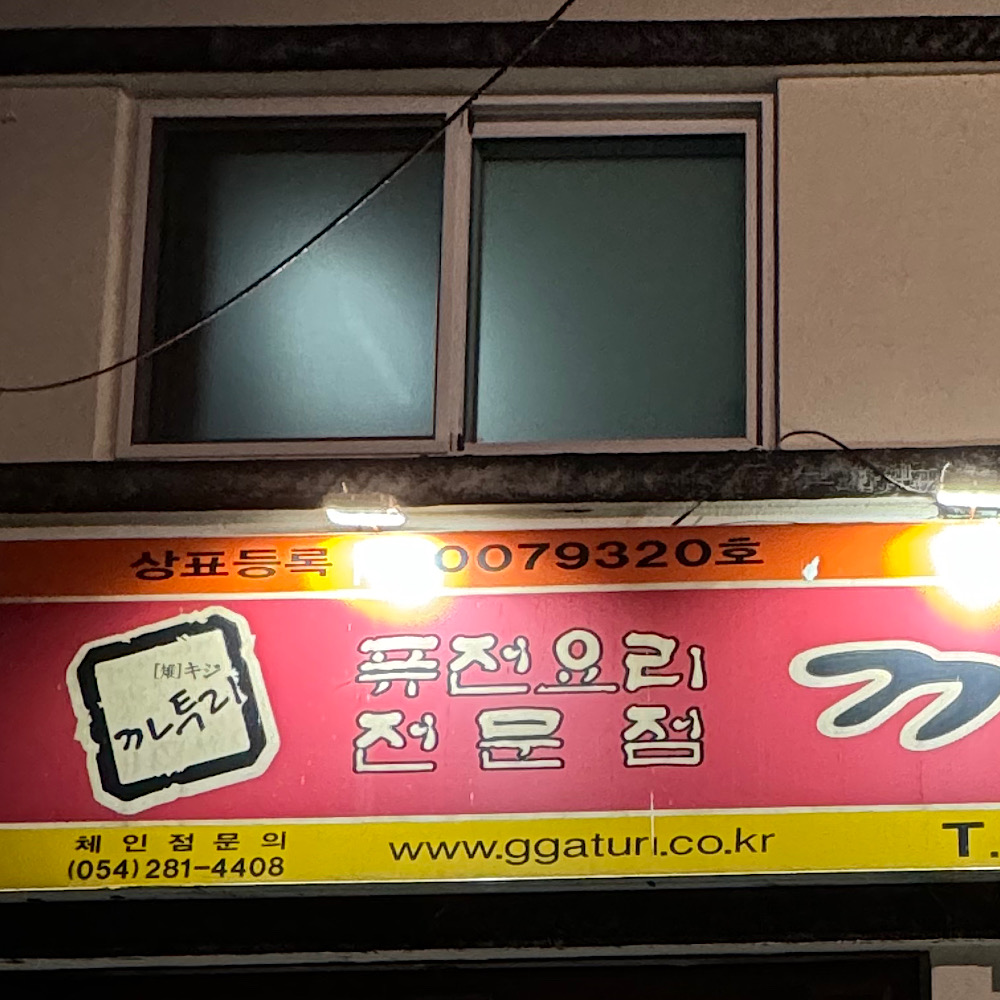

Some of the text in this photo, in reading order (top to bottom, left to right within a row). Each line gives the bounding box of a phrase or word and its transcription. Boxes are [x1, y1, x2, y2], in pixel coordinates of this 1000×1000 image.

[129, 548, 332, 581] 상표등록
[356, 628, 707, 697] 퓨전요리
[114, 676, 243, 751] 까투리
[388, 827, 776, 866] www.ggaturi.co.kr
[68, 856, 284, 881] (054)281-4408
